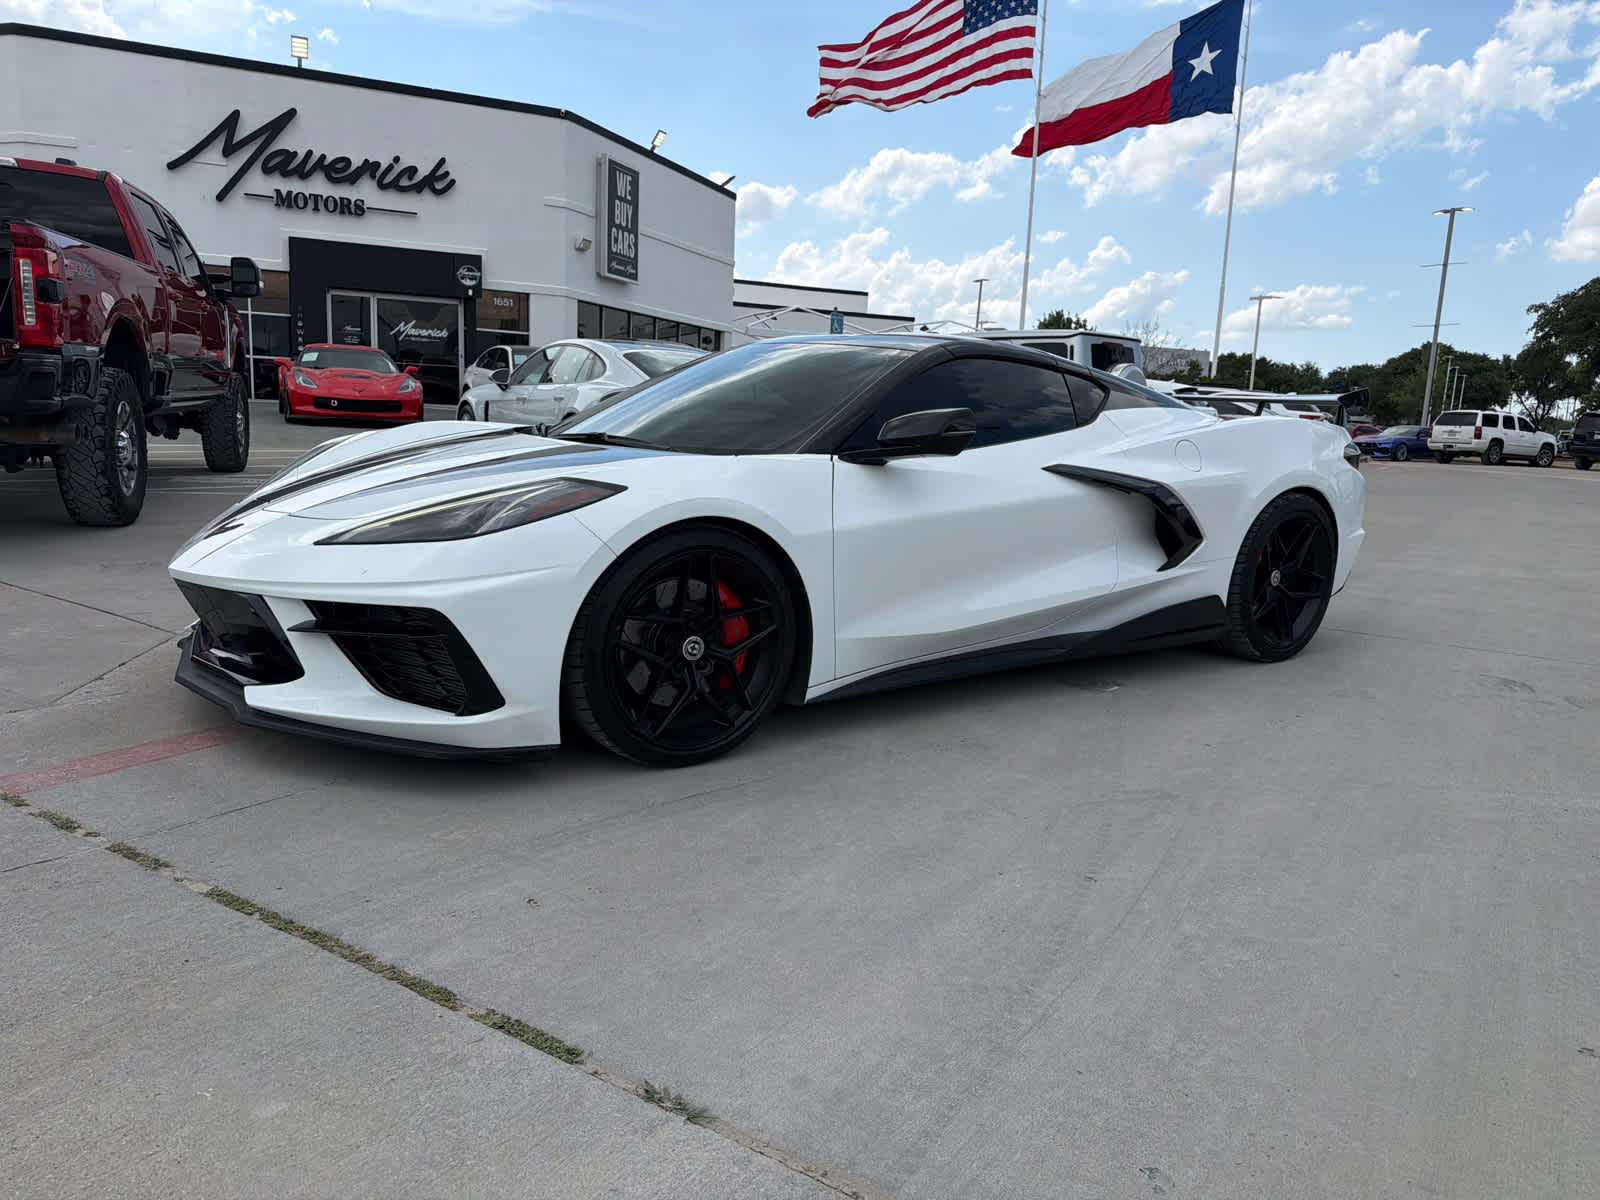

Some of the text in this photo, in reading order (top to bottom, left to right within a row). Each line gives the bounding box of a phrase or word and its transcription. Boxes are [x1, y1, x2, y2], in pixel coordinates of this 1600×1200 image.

[166, 107, 456, 202] Maverick
[616, 170, 632, 200] WE
[273, 188, 366, 217] MOTORS
[614, 199, 633, 228] BUY
[611, 227, 635, 258] CARS
[494, 297, 513, 307] 1651
[390, 319, 449, 341] Maverick
